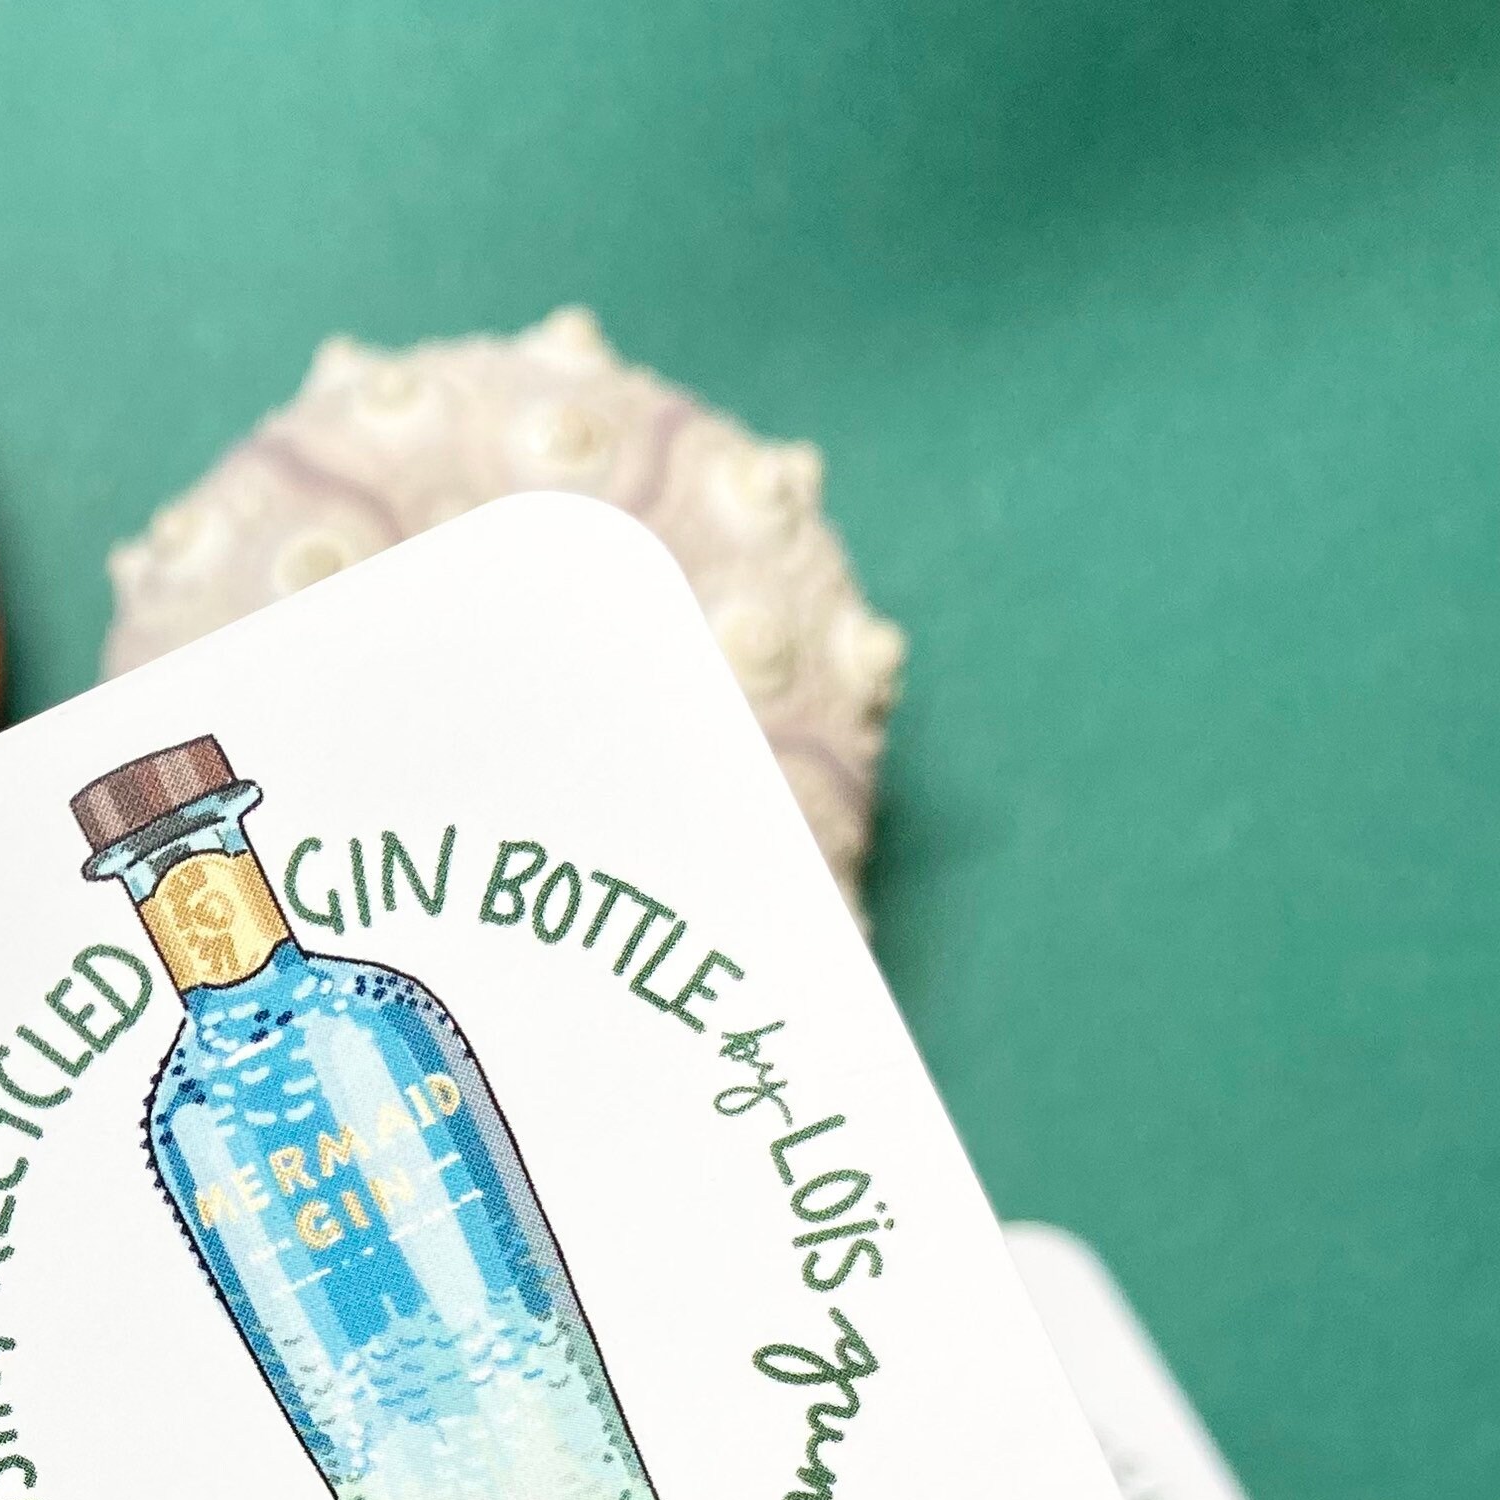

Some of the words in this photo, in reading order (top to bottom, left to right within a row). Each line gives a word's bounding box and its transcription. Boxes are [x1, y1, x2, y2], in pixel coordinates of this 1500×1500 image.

[284, 825, 457, 934] GIN
[478, 839, 746, 1034] BOTTLE
[713, 1020, 793, 1127] by
[196, 1071, 462, 1229] MERMAID
[295, 1168, 414, 1250] GIN
